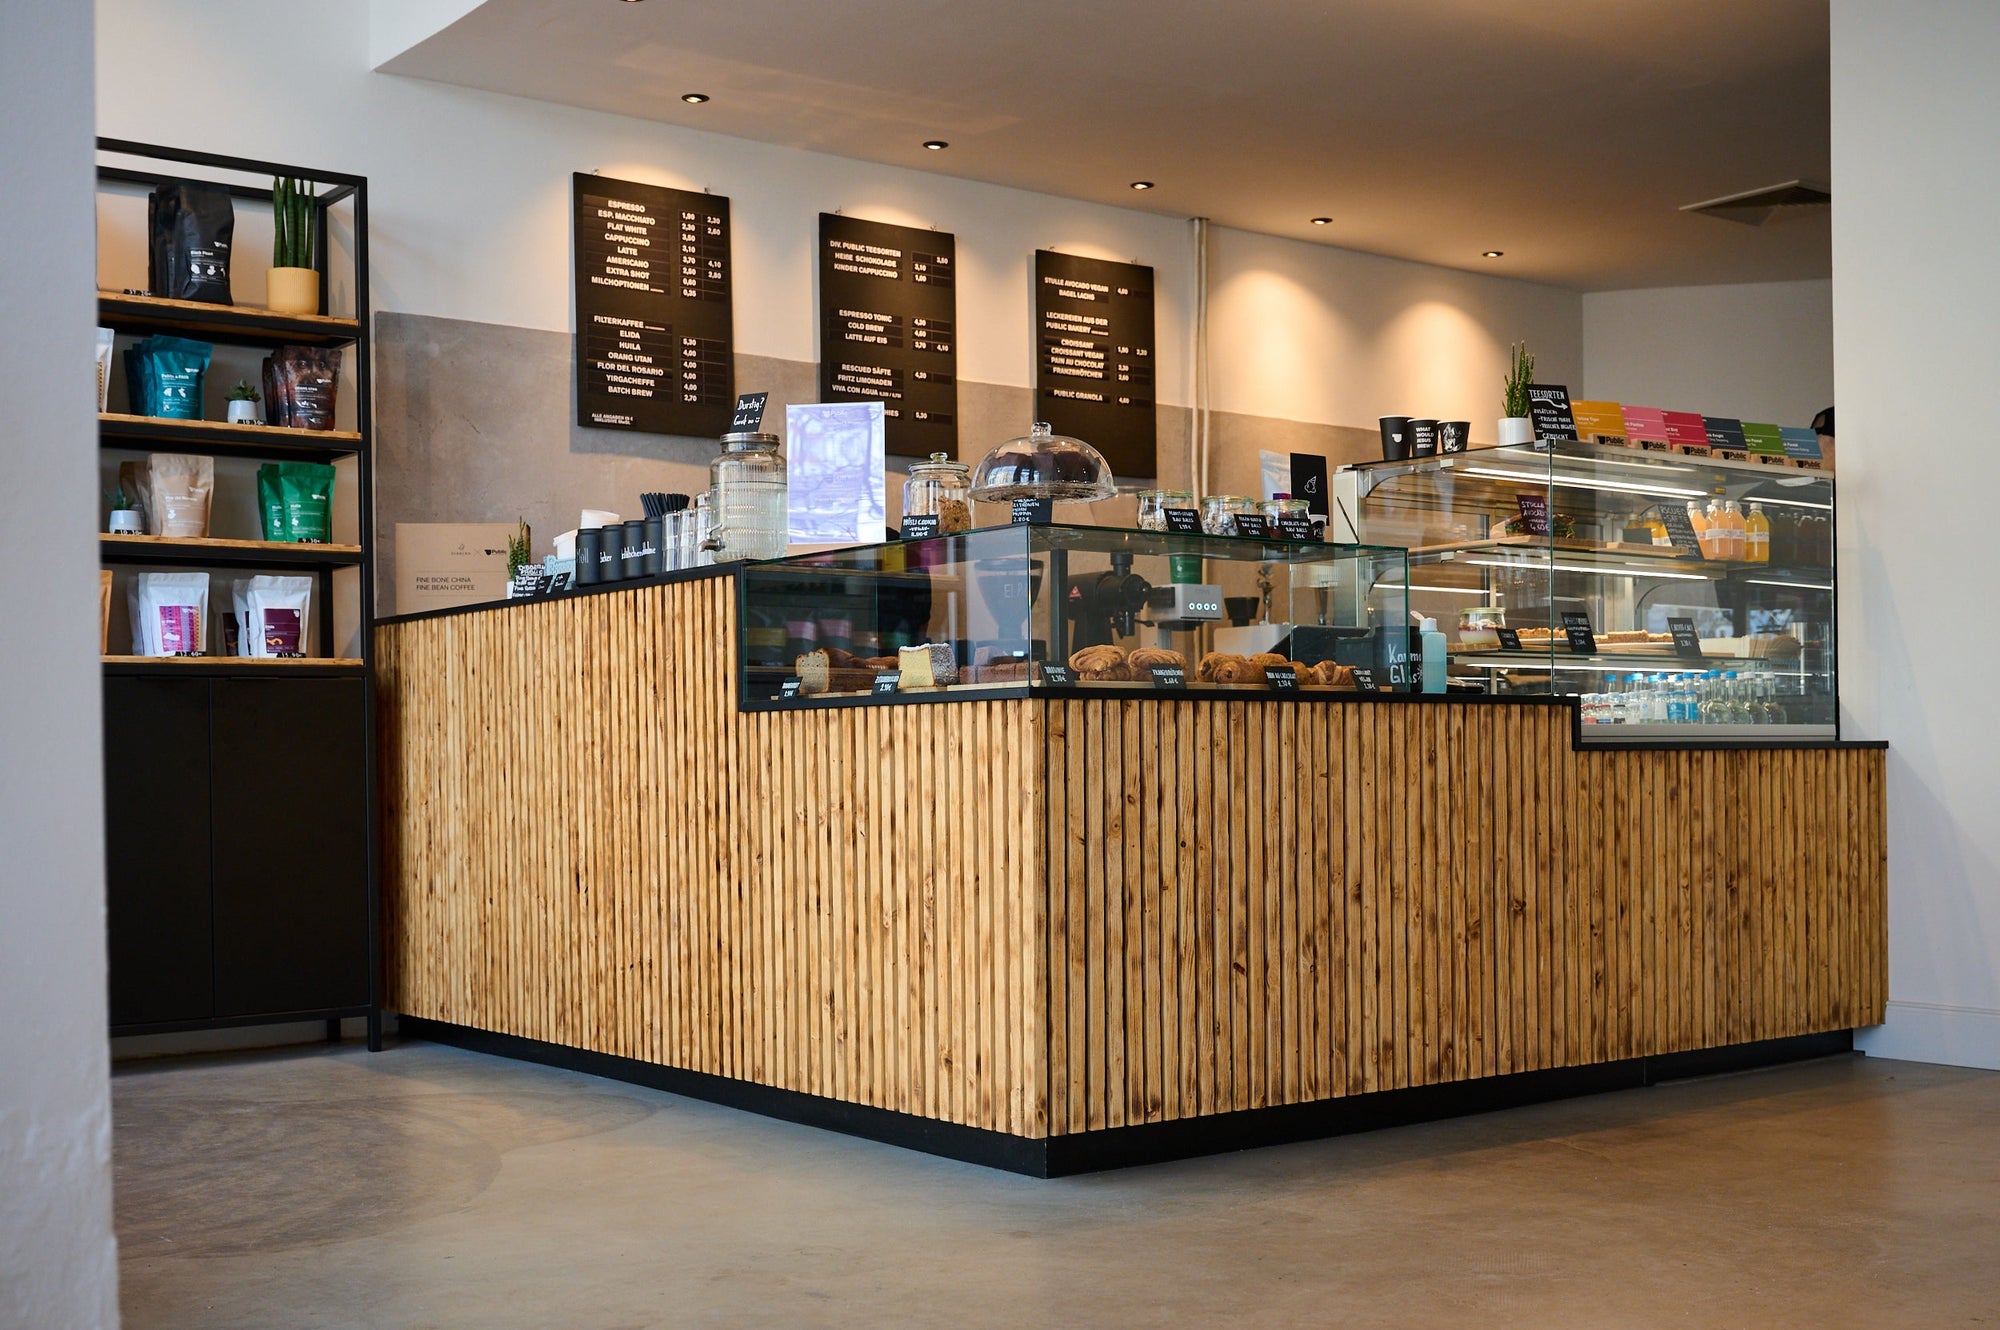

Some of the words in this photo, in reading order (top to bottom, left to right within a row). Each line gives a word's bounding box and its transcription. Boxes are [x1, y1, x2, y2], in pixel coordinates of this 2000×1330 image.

[608, 200, 645, 212] ESPRESSO
[598, 210, 614, 219] ESP.
[615, 212, 655, 226] MACCHIATO
[607, 222, 625, 232] FLAT
[625, 225, 647, 235] WHITE
[605, 233, 650, 246] CAPPUCCINO
[618, 246, 638, 256] LATTE
[842, 242, 865, 252] PUBLIC
[866, 246, 901, 258] TEESORTEN
[606, 256, 649, 269] AMERICANO
[708, 260, 721, 268] 4,10
[855, 255, 897, 268] SCHOKOLADE
[606, 267, 629, 277] EXTRA
[630, 270, 650, 280] SHOT
[834, 263, 858, 273] KINDER
[859, 267, 898, 279] CAPPUCCINO
[591, 276, 649, 291] MILCHOPTIONEN
[1045, 277, 1064, 286] STULLE
[1065, 280, 1089, 290] AVOCADO
[1090, 283, 1109, 293] VEGAN
[1059, 289, 1076, 298] BAGEL
[1077, 292, 1095, 301] LACHS
[594, 315, 644, 329] FILTERKAFFEE
[839, 309, 873, 320] ESPRESSO
[873, 314, 892, 322] TONIC
[1046, 312, 1082, 323] LECKEREIEN
[1083, 316, 1095, 325] AUS
[1096, 318, 1108, 326] DER
[848, 322, 865, 330] COLD
[865, 324, 884, 332] BREW
[1046, 321, 1067, 331] PUBLIC
[1068, 324, 1091, 334] BAKERY
[620, 330, 640, 339] ELIDA
[845, 333, 863, 342] LATTE
[863, 335, 876, 343] AUF
[619, 341, 641, 351] HUILA
[1061, 339, 1094, 349] CROISSANT
[1051, 347, 1084, 358] CROISSANT
[1084, 350, 1104, 360] VEGAN
[608, 352, 634, 362] ORANG
[634, 355, 652, 364] UTAN
[683, 361, 697, 369] 4,00
[1050, 356, 1065, 364] PAIN
[1065, 358, 1074, 366] AU
[1074, 359, 1104, 369] CHOCOLAT
[597, 362, 615, 371] FLOR
[616, 364, 630, 372] DEL
[631, 366, 663, 376] ROSARIO
[683, 372, 697, 380] 4,00
[842, 364, 872, 374] RESCUED
[872, 366, 892, 376] SÄFTE
[1052, 366, 1103, 379] FRANZBRÖTCHEN
[606, 374, 655, 387] YIRGACHEFFE
[837, 374, 855, 383] FRITZ
[856, 376, 893, 387] LIMONADEN
[608, 385, 630, 395] BATCH
[631, 388, 653, 397] BREW
[832, 384, 846, 393] VIVA
[847, 386, 860, 394] CON
[861, 388, 879, 396] AGUA
[1054, 389, 1075, 398] PUBLIC
[1076, 391, 1103, 402] GRANOLA
[1528, 389, 1565, 400] TEESORTEN
[737, 397, 765, 412] Durstig?
[1606, 436, 1624, 444] Public
[1649, 442, 1666, 450] Public
[1690, 446, 1708, 455] Public
[1729, 452, 1747, 460] Public
[1767, 456, 1784, 464] Public
[1803, 460, 1821, 468] Public
